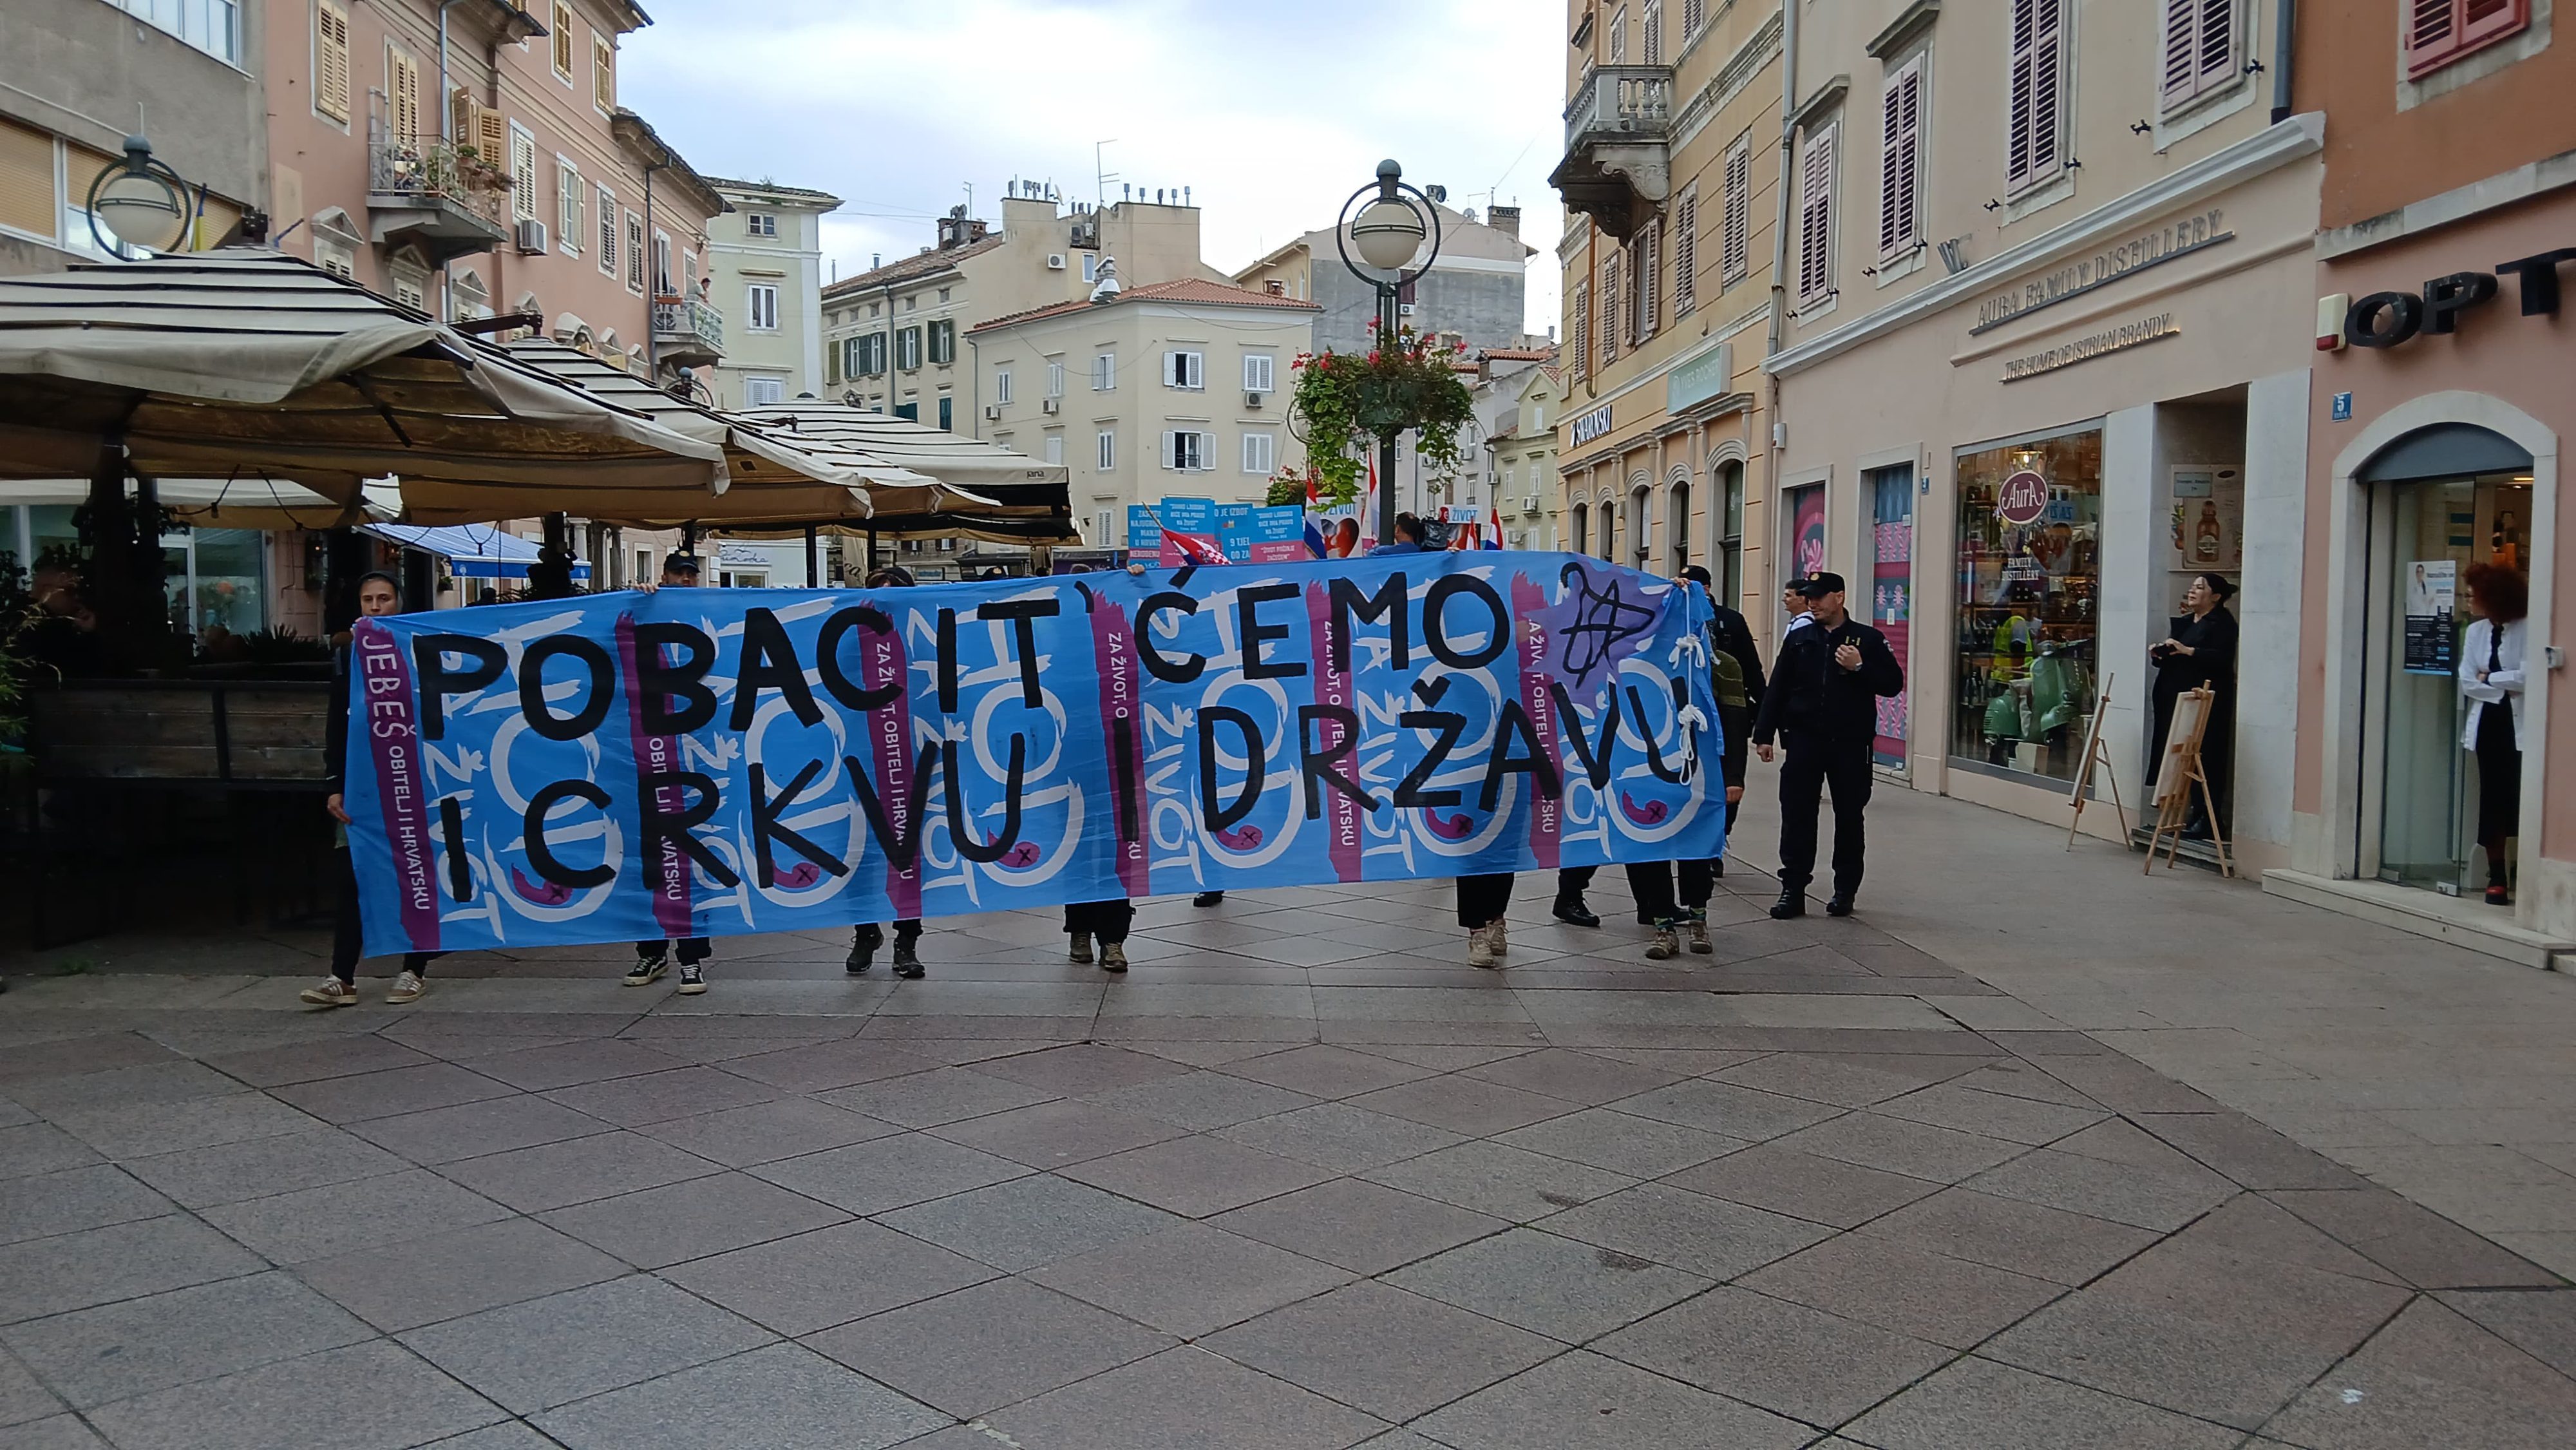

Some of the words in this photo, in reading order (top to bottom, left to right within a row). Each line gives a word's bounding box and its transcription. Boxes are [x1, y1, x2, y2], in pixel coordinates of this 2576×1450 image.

[1978, 291, 2018, 327] AURA
[2026, 262, 2088, 307] FAMILY
[2096, 209, 2223, 281] DISTILLERY
[2119, 313, 2170, 347] BRANDY
[2337, 395, 2345, 412] 5
[876, 642, 891, 665] ZA
[1108, 632, 1124, 654] ZA
[1134, 565, 1510, 683] ĆEMO
[362, 635, 417, 738] JEBEŠ
[879, 667, 896, 718] ŽIT,
[389, 745, 413, 814] OBITELJ
[440, 797, 472, 902] I
[524, 733, 1025, 889] CRKVU
[1113, 719, 1139, 841] I
[1197, 674, 1698, 832] DRŽAVU
[884, 721, 904, 785] OBITELJ
[1143, 701, 1204, 886] ŽIVOT
[1357, 689, 1416, 875] ŽIVOT
[650, 738, 671, 806] OBITLJ
[661, 834, 682, 901] VATSKU
[892, 794, 913, 880] HRVAU
[1336, 766, 1355, 846] HVATSKU
[399, 825, 430, 910] HRVATSKU
